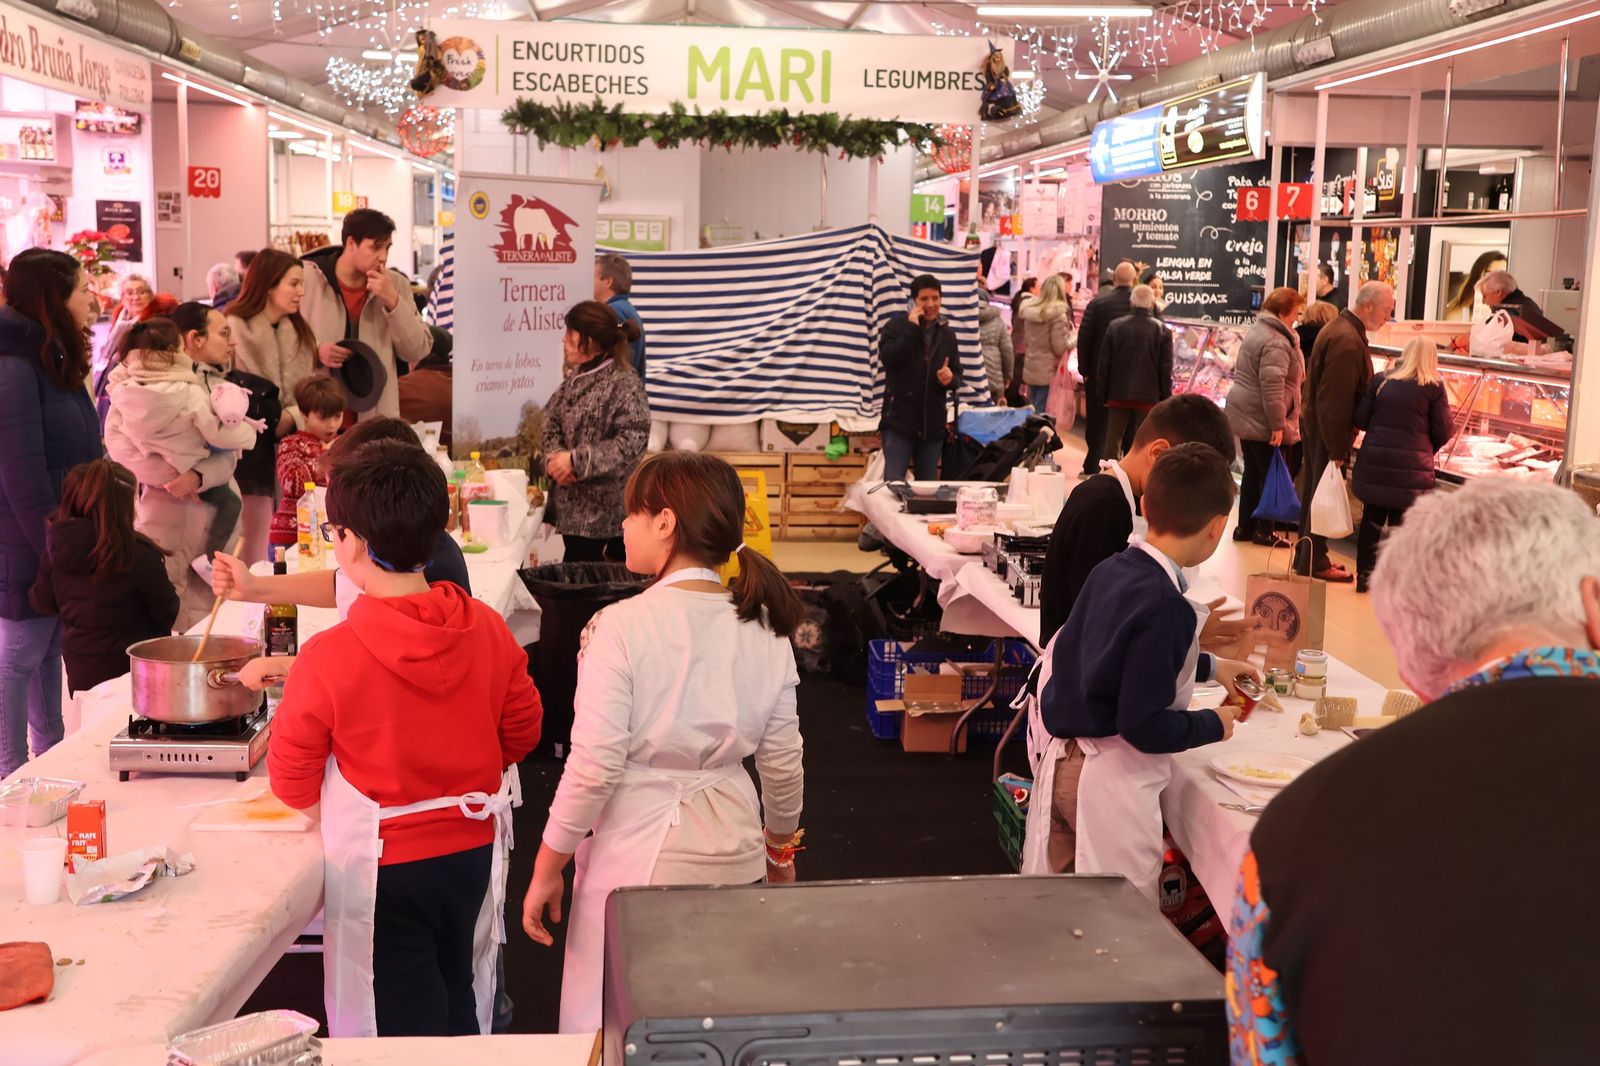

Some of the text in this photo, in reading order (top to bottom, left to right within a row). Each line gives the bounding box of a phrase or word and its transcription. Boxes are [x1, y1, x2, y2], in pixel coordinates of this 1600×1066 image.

[512, 40, 645, 65] ENCURTIDOS
[28, 24, 75, 84] Bruña
[78, 43, 111, 101] Jorge
[687, 45, 832, 104] MARI
[863, 69, 985, 92] LEGUMBRES
[512, 72, 649, 96] ESCABECHES
[193, 169, 220, 189] 20
[1228, 176, 1253, 187] Pata
[924, 197, 941, 214] 14
[1245, 190, 1259, 211] 6
[1286, 186, 1300, 207] 7
[1114, 208, 1168, 222] MORRO
[1132, 220, 1179, 232] pimientos
[1137, 232, 1143, 242] y
[501, 250, 540, 262] TERNERA
[545, 250, 573, 262] ALISTE
[1156, 257, 1212, 269] LENGUA EN
[1155, 270, 1212, 282] SALSA VERDE
[1236, 264, 1267, 278] galleg
[500, 277, 566, 302] Ternera
[1165, 292, 1218, 305] GUISADA
[503, 307, 564, 332] de Aliste
[514, 352, 542, 369] lobos,
[475, 371, 535, 395] criamos jatos
